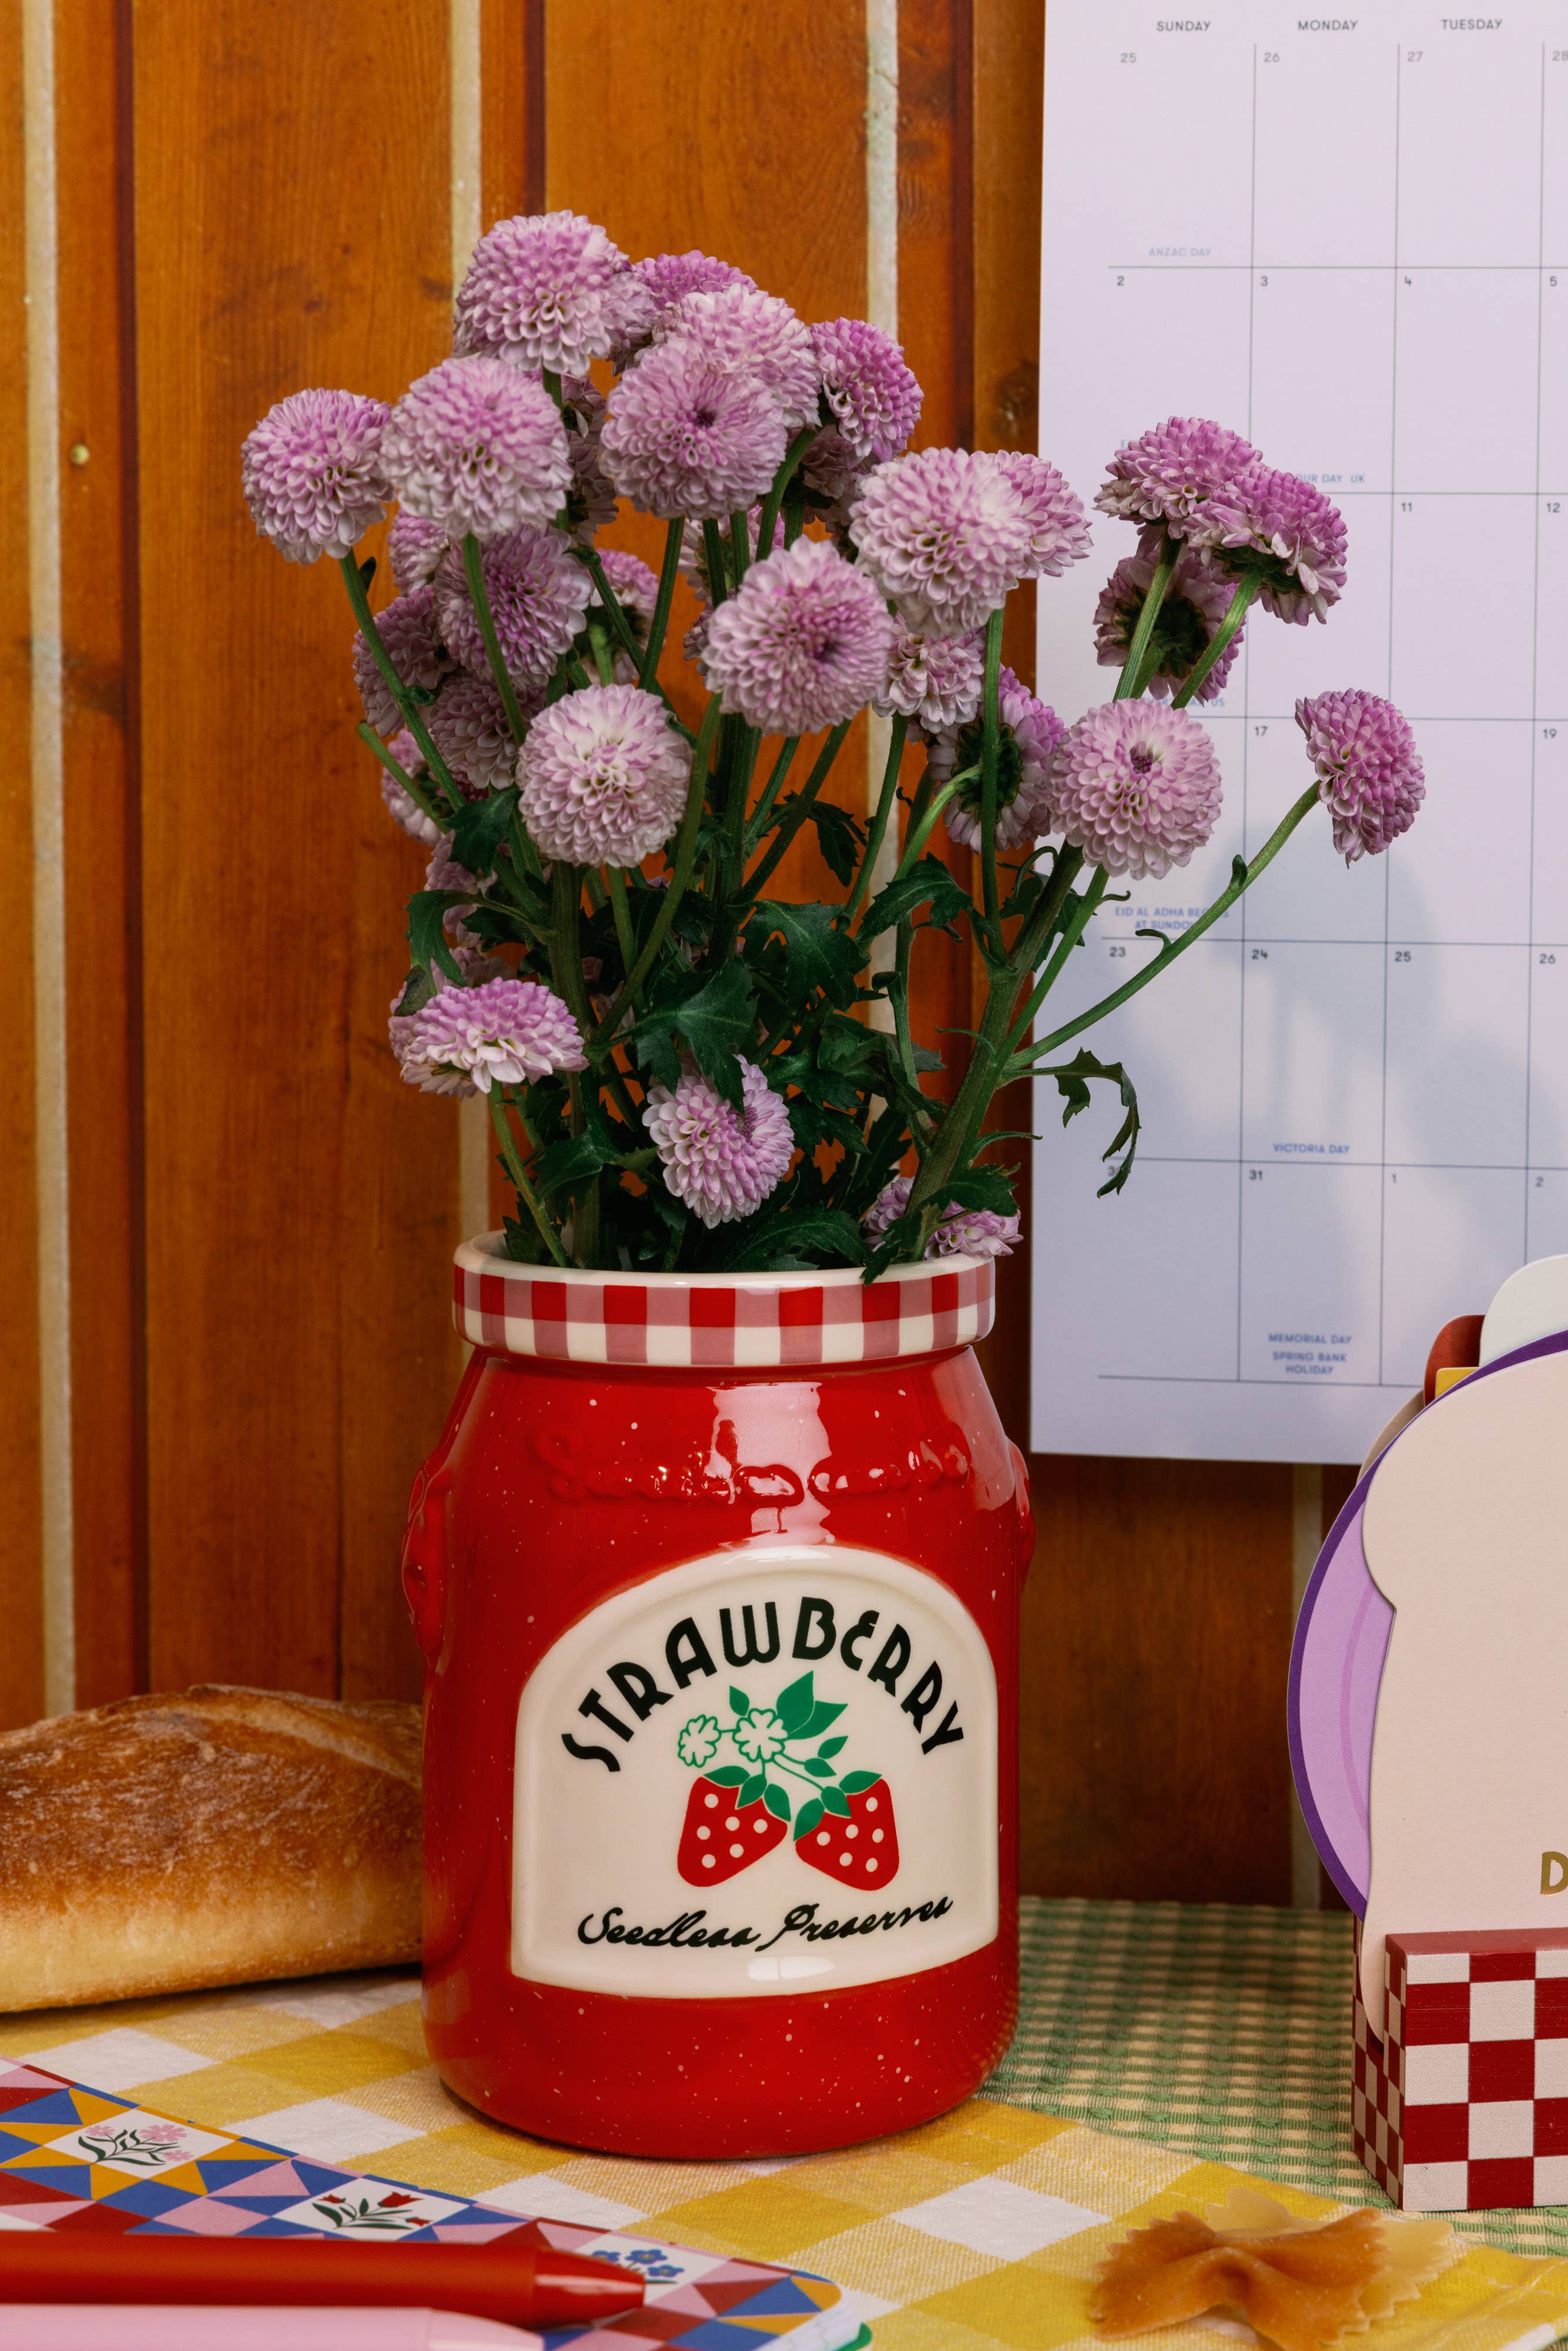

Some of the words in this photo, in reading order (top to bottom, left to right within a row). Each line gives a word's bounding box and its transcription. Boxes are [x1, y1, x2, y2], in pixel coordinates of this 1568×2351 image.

[1157, 21, 1211, 31] SUNDAY
[1298, 20, 1357, 31] MONDAY
[1442, 19, 1502, 29] TUESDAY
[1120, 53, 1136, 63] 25
[1264, 52, 1279, 62] 26
[1408, 51, 1423, 62] 27
[1553, 51, 1568, 61] 28
[1149, 247, 1186, 256] ANZAC
[1191, 248, 1211, 256] DAY
[1117, 276, 1124, 286] 2
[1261, 276, 1268, 286] 3
[1405, 277, 1412, 286] 4
[1550, 276, 1557, 286] 5
[1322, 474, 1342, 483] DAY
[1351, 475, 1364, 483] UK
[1402, 503, 1412, 511] 11
[1547, 503, 1560, 513] 12
[1255, 726, 1268, 736] 17
[1543, 729, 1557, 738] 19
[1115, 907, 1134, 916] EID
[1137, 907, 1148, 917] AL
[1154, 907, 1184, 917] ADHA
[1135, 920, 1147, 929] AT
[1110, 947, 1125, 957] 23
[1252, 949, 1268, 959] 24
[1395, 951, 1411, 962] 25
[1539, 953, 1556, 964] 26
[1273, 1143, 1325, 1153] VICTORIA
[1329, 1144, 1349, 1154] DAY
[1107, 1166, 1121, 1177] 3
[1249, 1170, 1262, 1180] 31
[1392, 1174, 1396, 1183] 1
[1536, 1177, 1544, 1187] 2
[1269, 1334, 1325, 1344] MEMORIAL
[1331, 1334, 1352, 1344] DAY
[1273, 1352, 1314, 1361] SPRING
[1318, 1352, 1345, 1362] BANK
[1285, 1364, 1333, 1374] HOLIDAY
[561, 1596, 964, 1772] STRAWBERRY
[578, 1907, 762, 1948] Seedless
[755, 1895, 953, 1951] Preserves
